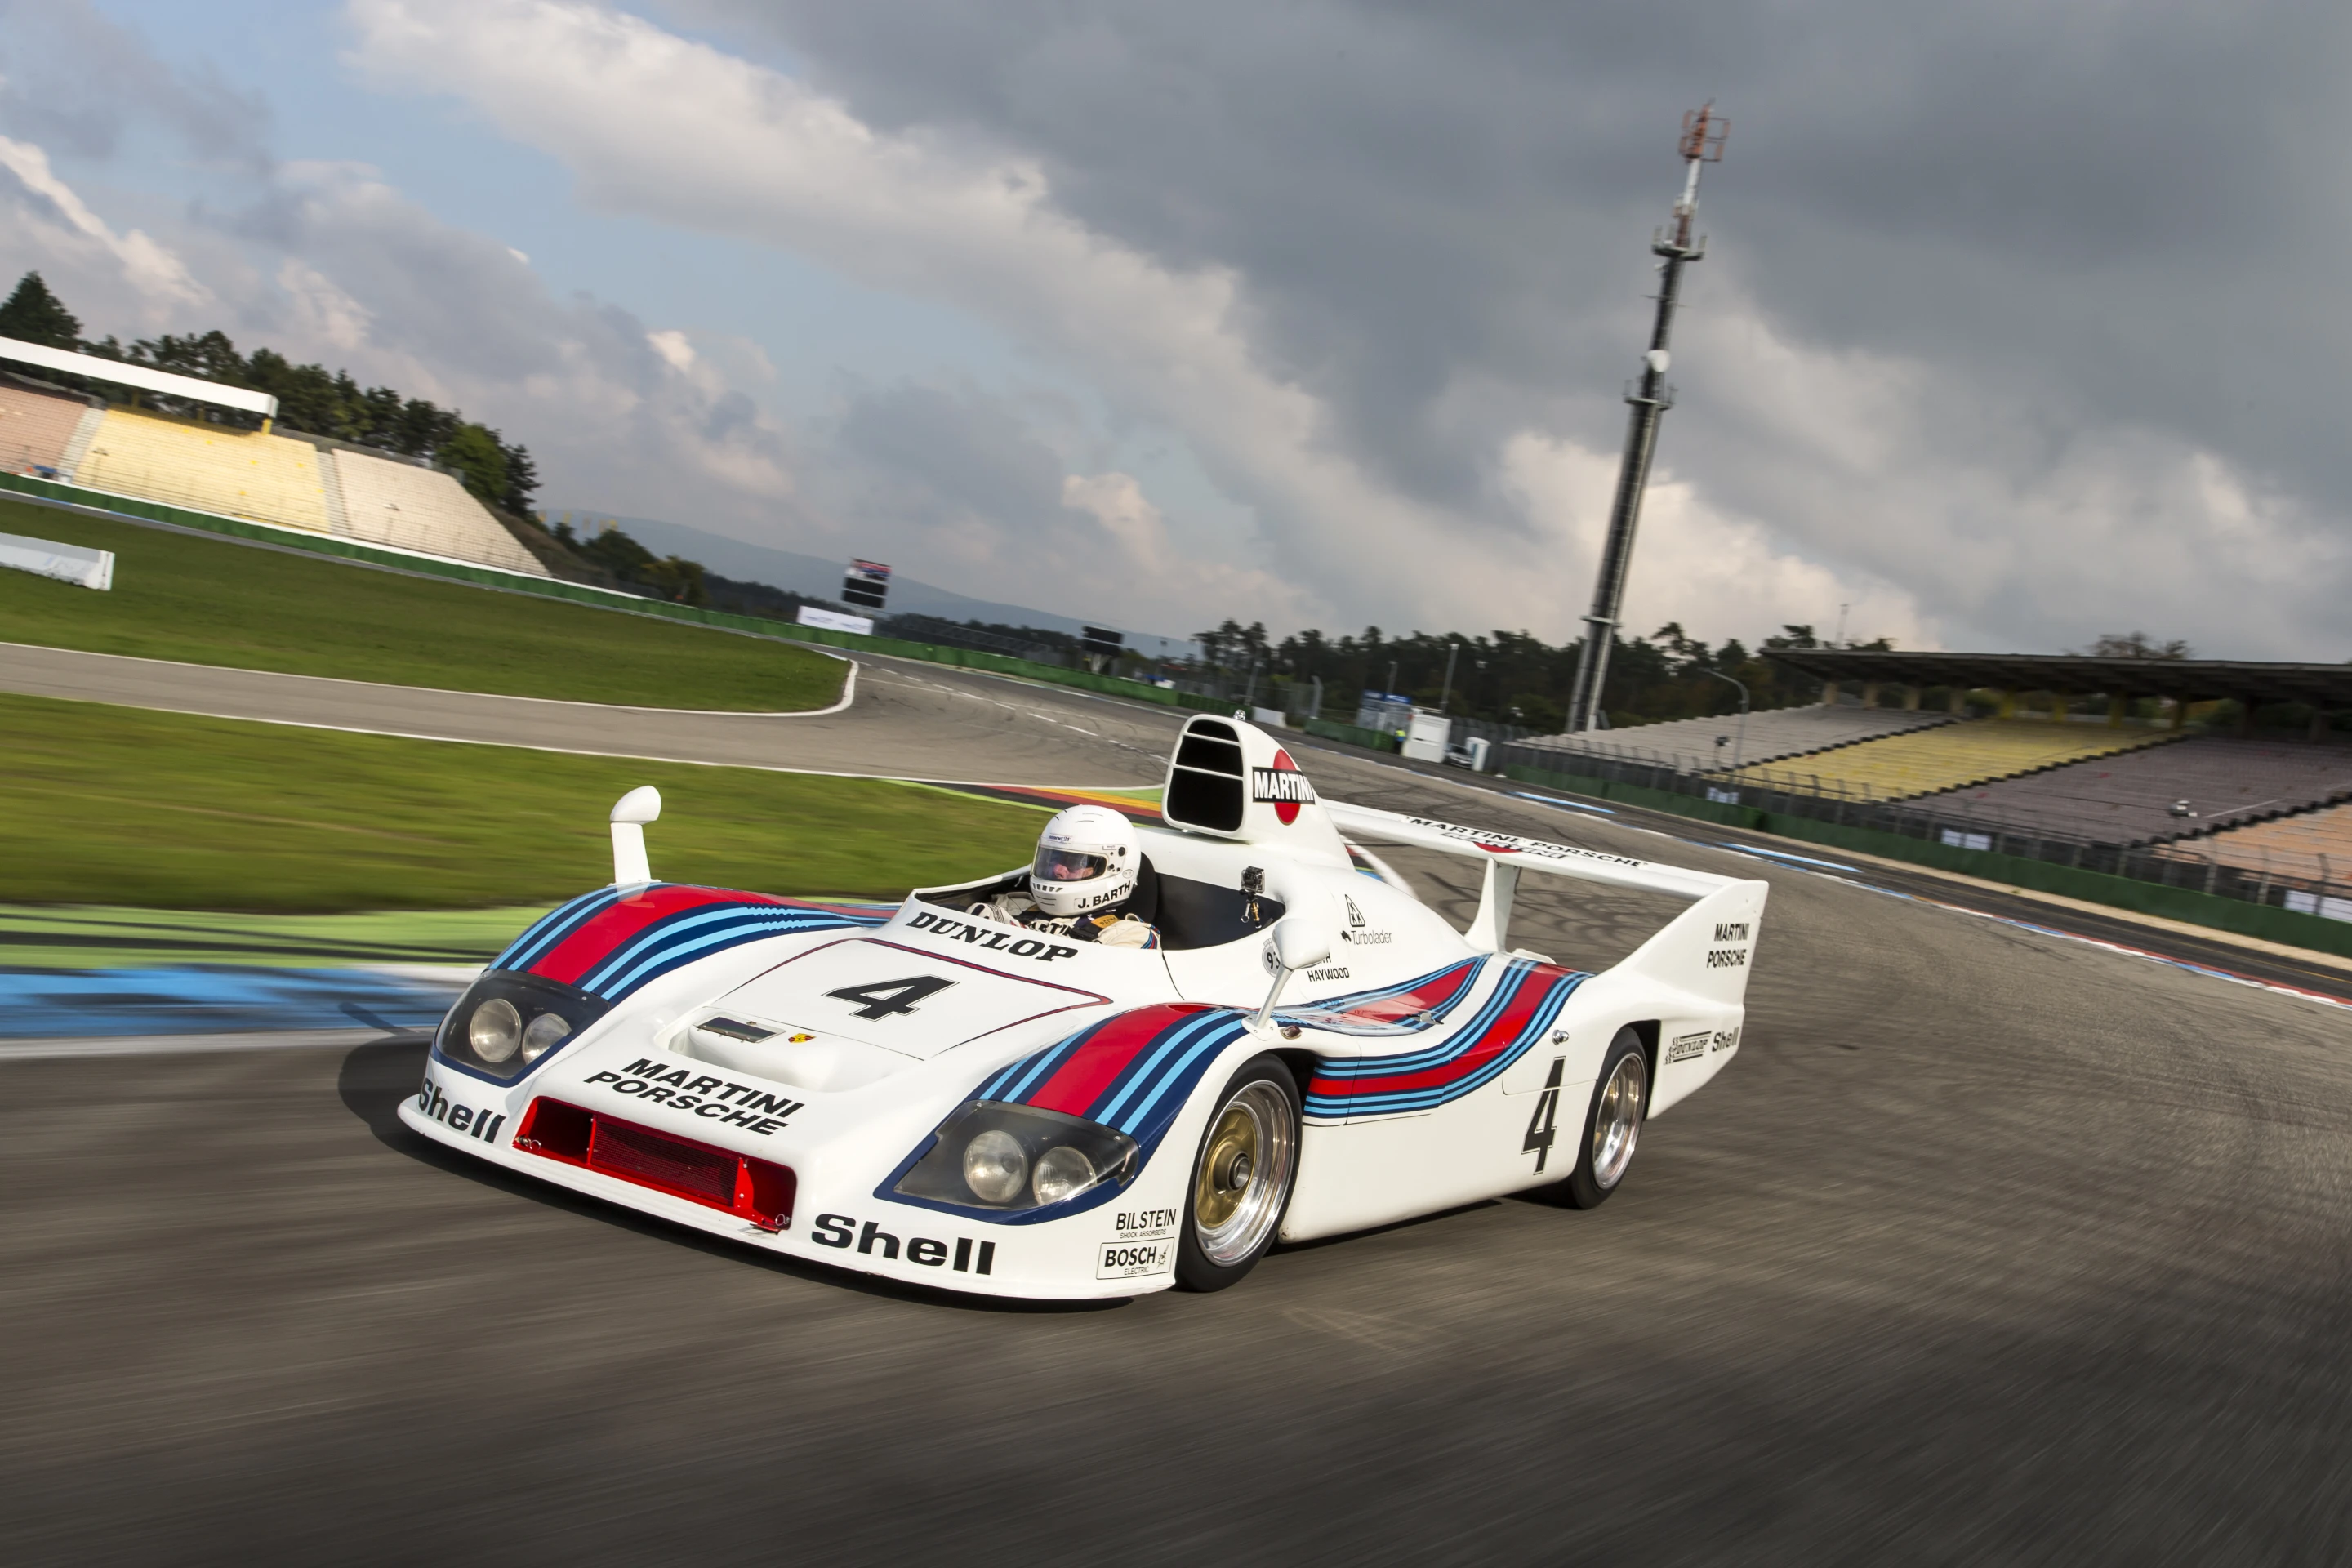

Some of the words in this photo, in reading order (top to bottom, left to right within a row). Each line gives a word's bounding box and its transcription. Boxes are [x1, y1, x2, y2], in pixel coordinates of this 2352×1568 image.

[1254, 770, 1315, 801] MARTINI
[1410, 817, 1519, 844] MARTINI
[1530, 840, 1643, 867] PORSCHE
[1077, 898, 1090, 909] J.
[1092, 880, 1131, 907] BARTH
[905, 911, 1080, 962] DUNLOP
[1350, 929, 1393, 946] Turbolader
[1713, 923, 1750, 942] MARTINI
[1706, 948, 1748, 969] PORSCHE
[1307, 967, 1350, 982] HAYWOOD
[821, 973, 960, 1022] 4
[1712, 1026, 1740, 1053] Shell
[621, 1058, 805, 1119] MARTINI
[418, 1077, 506, 1144] Shell
[583, 1071, 791, 1136] PORSCHE
[1521, 1055, 1566, 1176] 4
[1116, 1208, 1177, 1231] BILSTEIN
[1120, 1231, 1138, 1239] SHOCK
[1139, 1228, 1167, 1237] ABSORBERS
[811, 1213, 996, 1276] Shell
[1104, 1245, 1157, 1267] BOSCH
[1124, 1266, 1150, 1276] ELECTRIC
